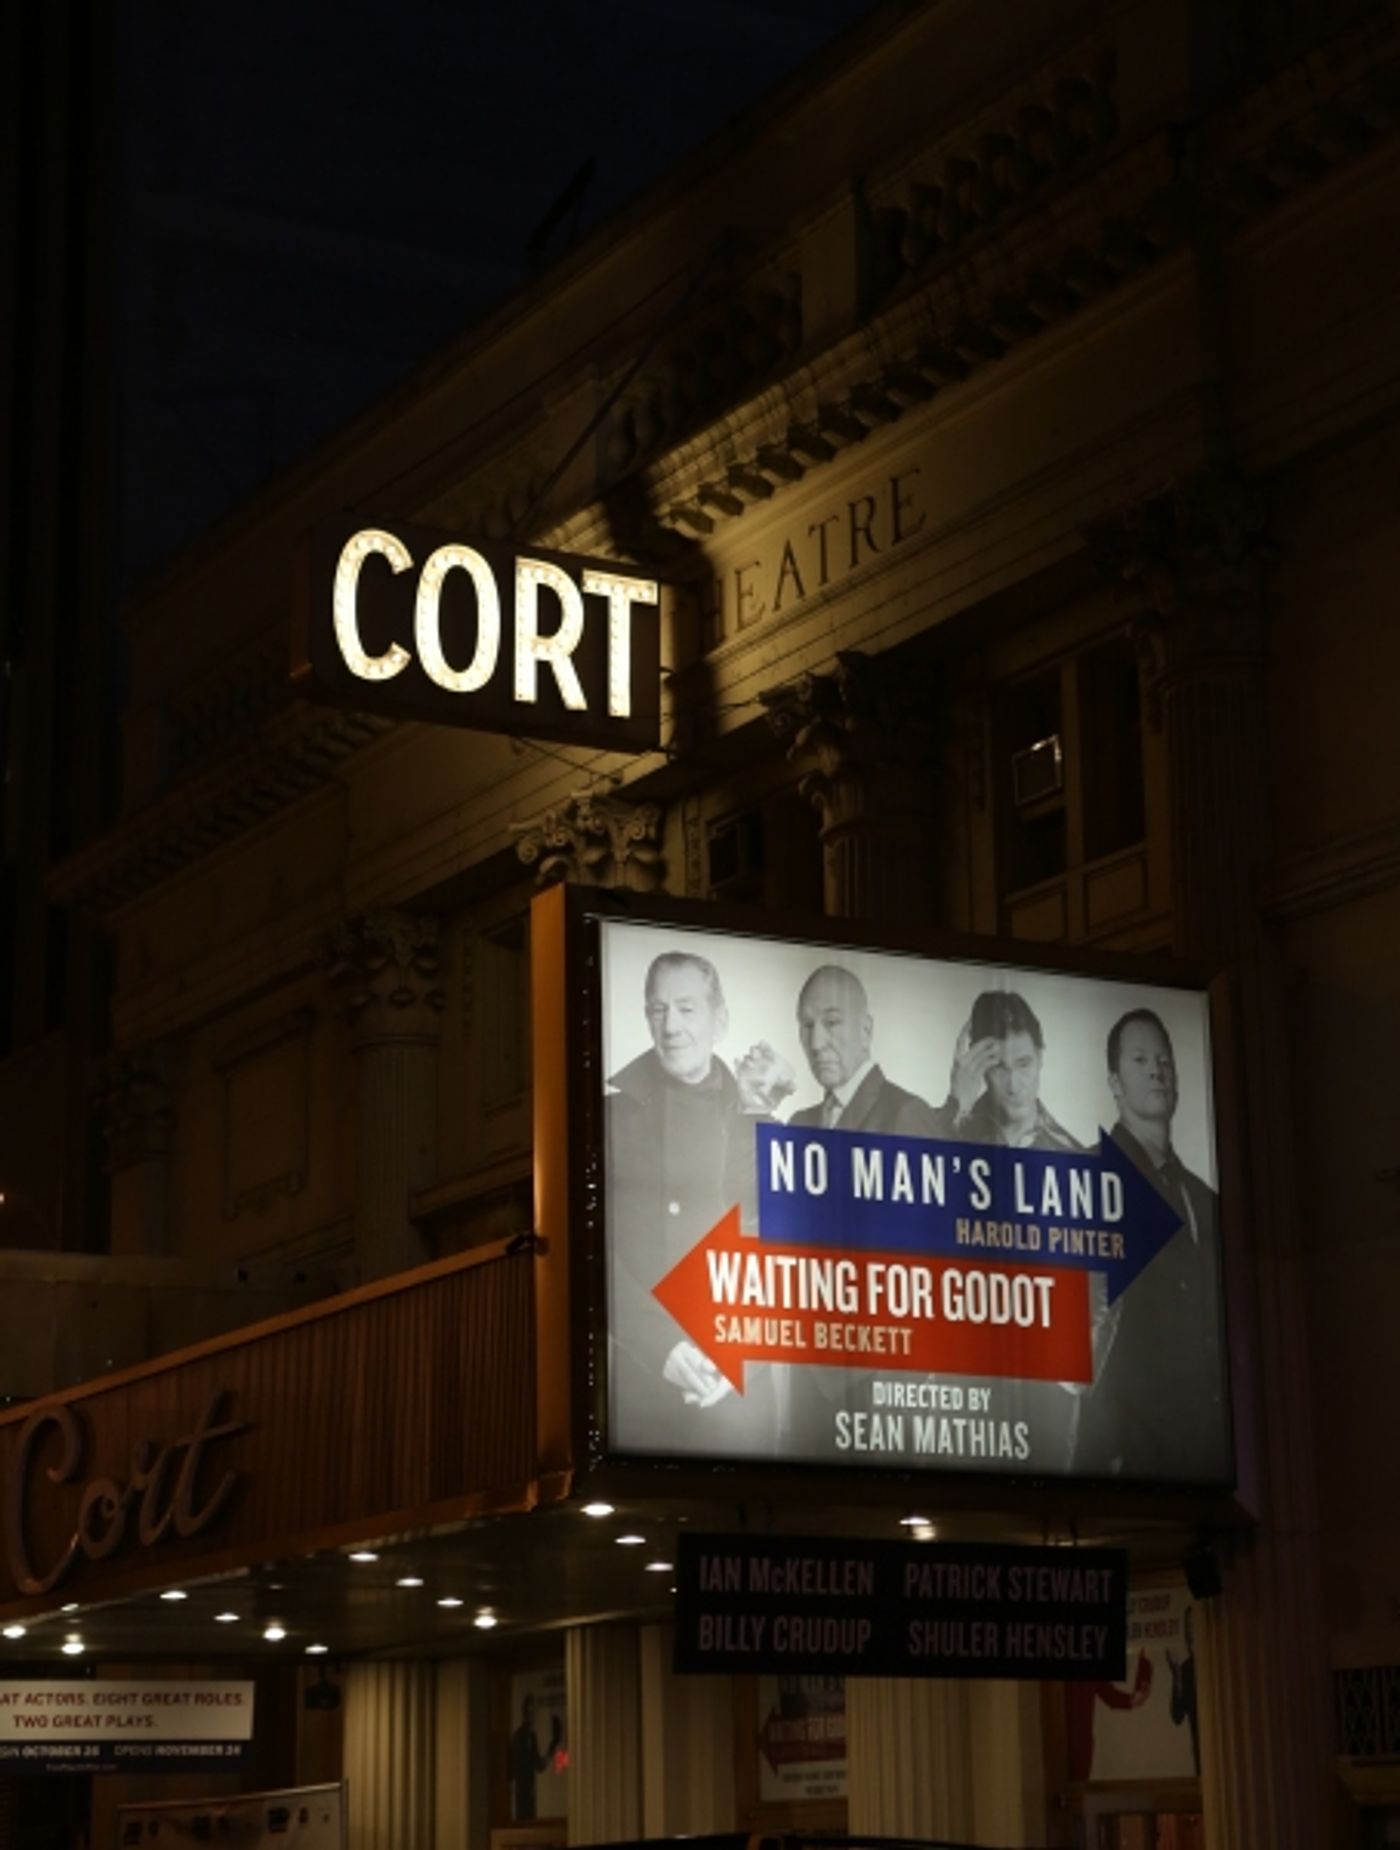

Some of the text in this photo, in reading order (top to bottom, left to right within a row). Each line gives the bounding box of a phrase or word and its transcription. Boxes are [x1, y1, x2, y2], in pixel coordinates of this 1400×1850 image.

[331, 527, 659, 719] CORT
[770, 1139, 1125, 1223] NO MAN'S LAND
[955, 1218, 1126, 1259] HAROLD PINTER
[706, 1249, 1055, 1329] WAITING FOR GODOT
[714, 1314, 913, 1356] SAMUEL BECKETT
[873, 1381, 992, 1413] DIRECTED BY
[835, 1412, 1030, 1461] SEAN MATHIAS
[7, 1390, 247, 1595] Cort
[700, 1554, 875, 1596] IAN McKELLEN
[904, 1561, 1114, 1604] PATRICK STEWART
[700, 1613, 872, 1655] BILLY CRUDUP
[908, 1617, 1000, 1659] SHULER
[1004, 1620, 1109, 1661] HENSLEY
[93, 1692, 138, 1706] EIGHT
[142, 1692, 191, 1706] GREAT
[13, 1714, 48, 1728] TWO
[52, 1714, 102, 1728] GREAT
